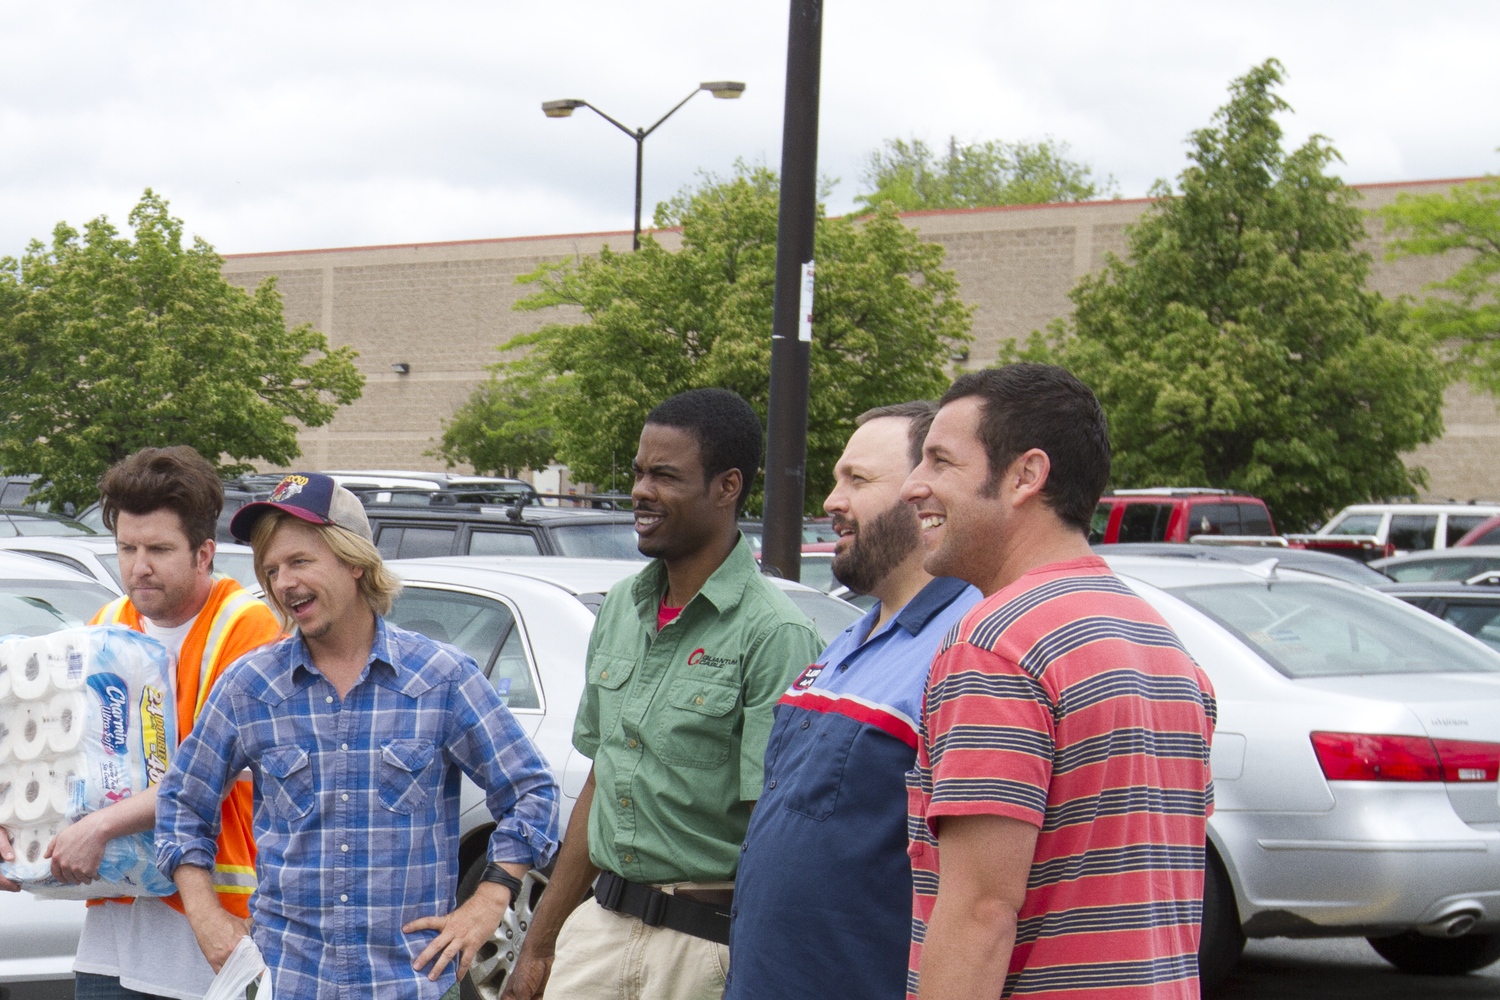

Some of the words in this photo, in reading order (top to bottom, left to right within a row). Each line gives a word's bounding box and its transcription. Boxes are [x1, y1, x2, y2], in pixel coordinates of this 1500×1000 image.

[698, 660, 726, 669] CABLE
[702, 654, 739, 666] QUANTUM
[105, 685, 127, 745] Charmin
[146, 687, 164, 718] 24
[100, 704, 113, 730] Ultra
[101, 731, 115, 752] Soft
[154, 715, 167, 761] DOUBLE
